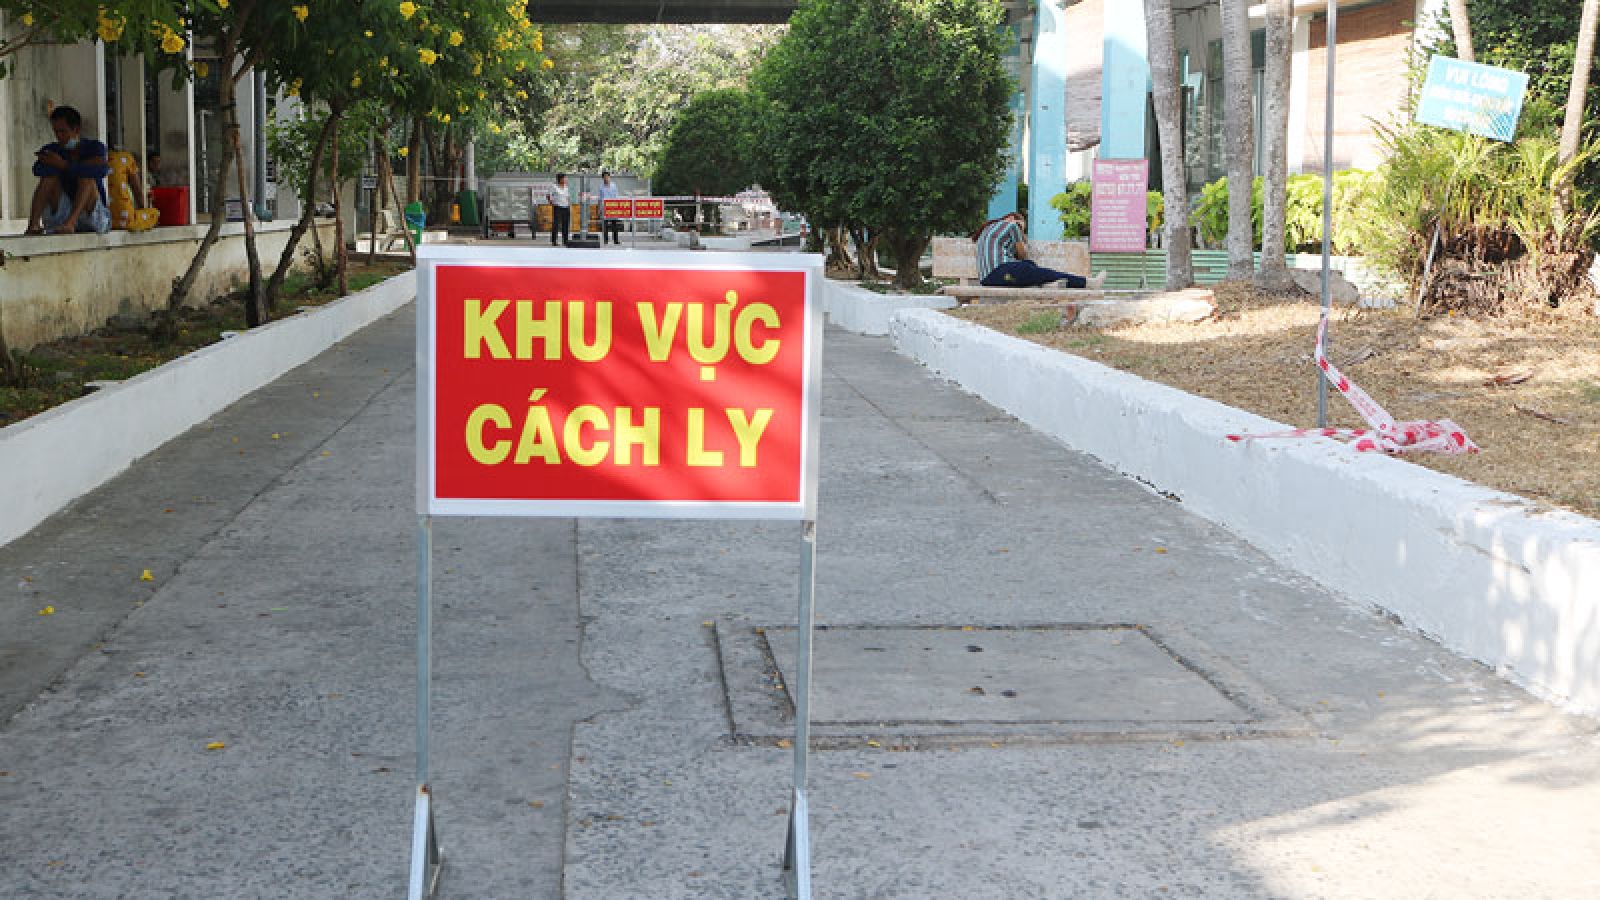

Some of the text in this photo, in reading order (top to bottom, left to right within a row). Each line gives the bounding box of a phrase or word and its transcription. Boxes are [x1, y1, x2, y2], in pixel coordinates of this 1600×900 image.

[463, 289, 781, 382] KHU VỰC
[465, 387, 775, 468] CÁCH LY
